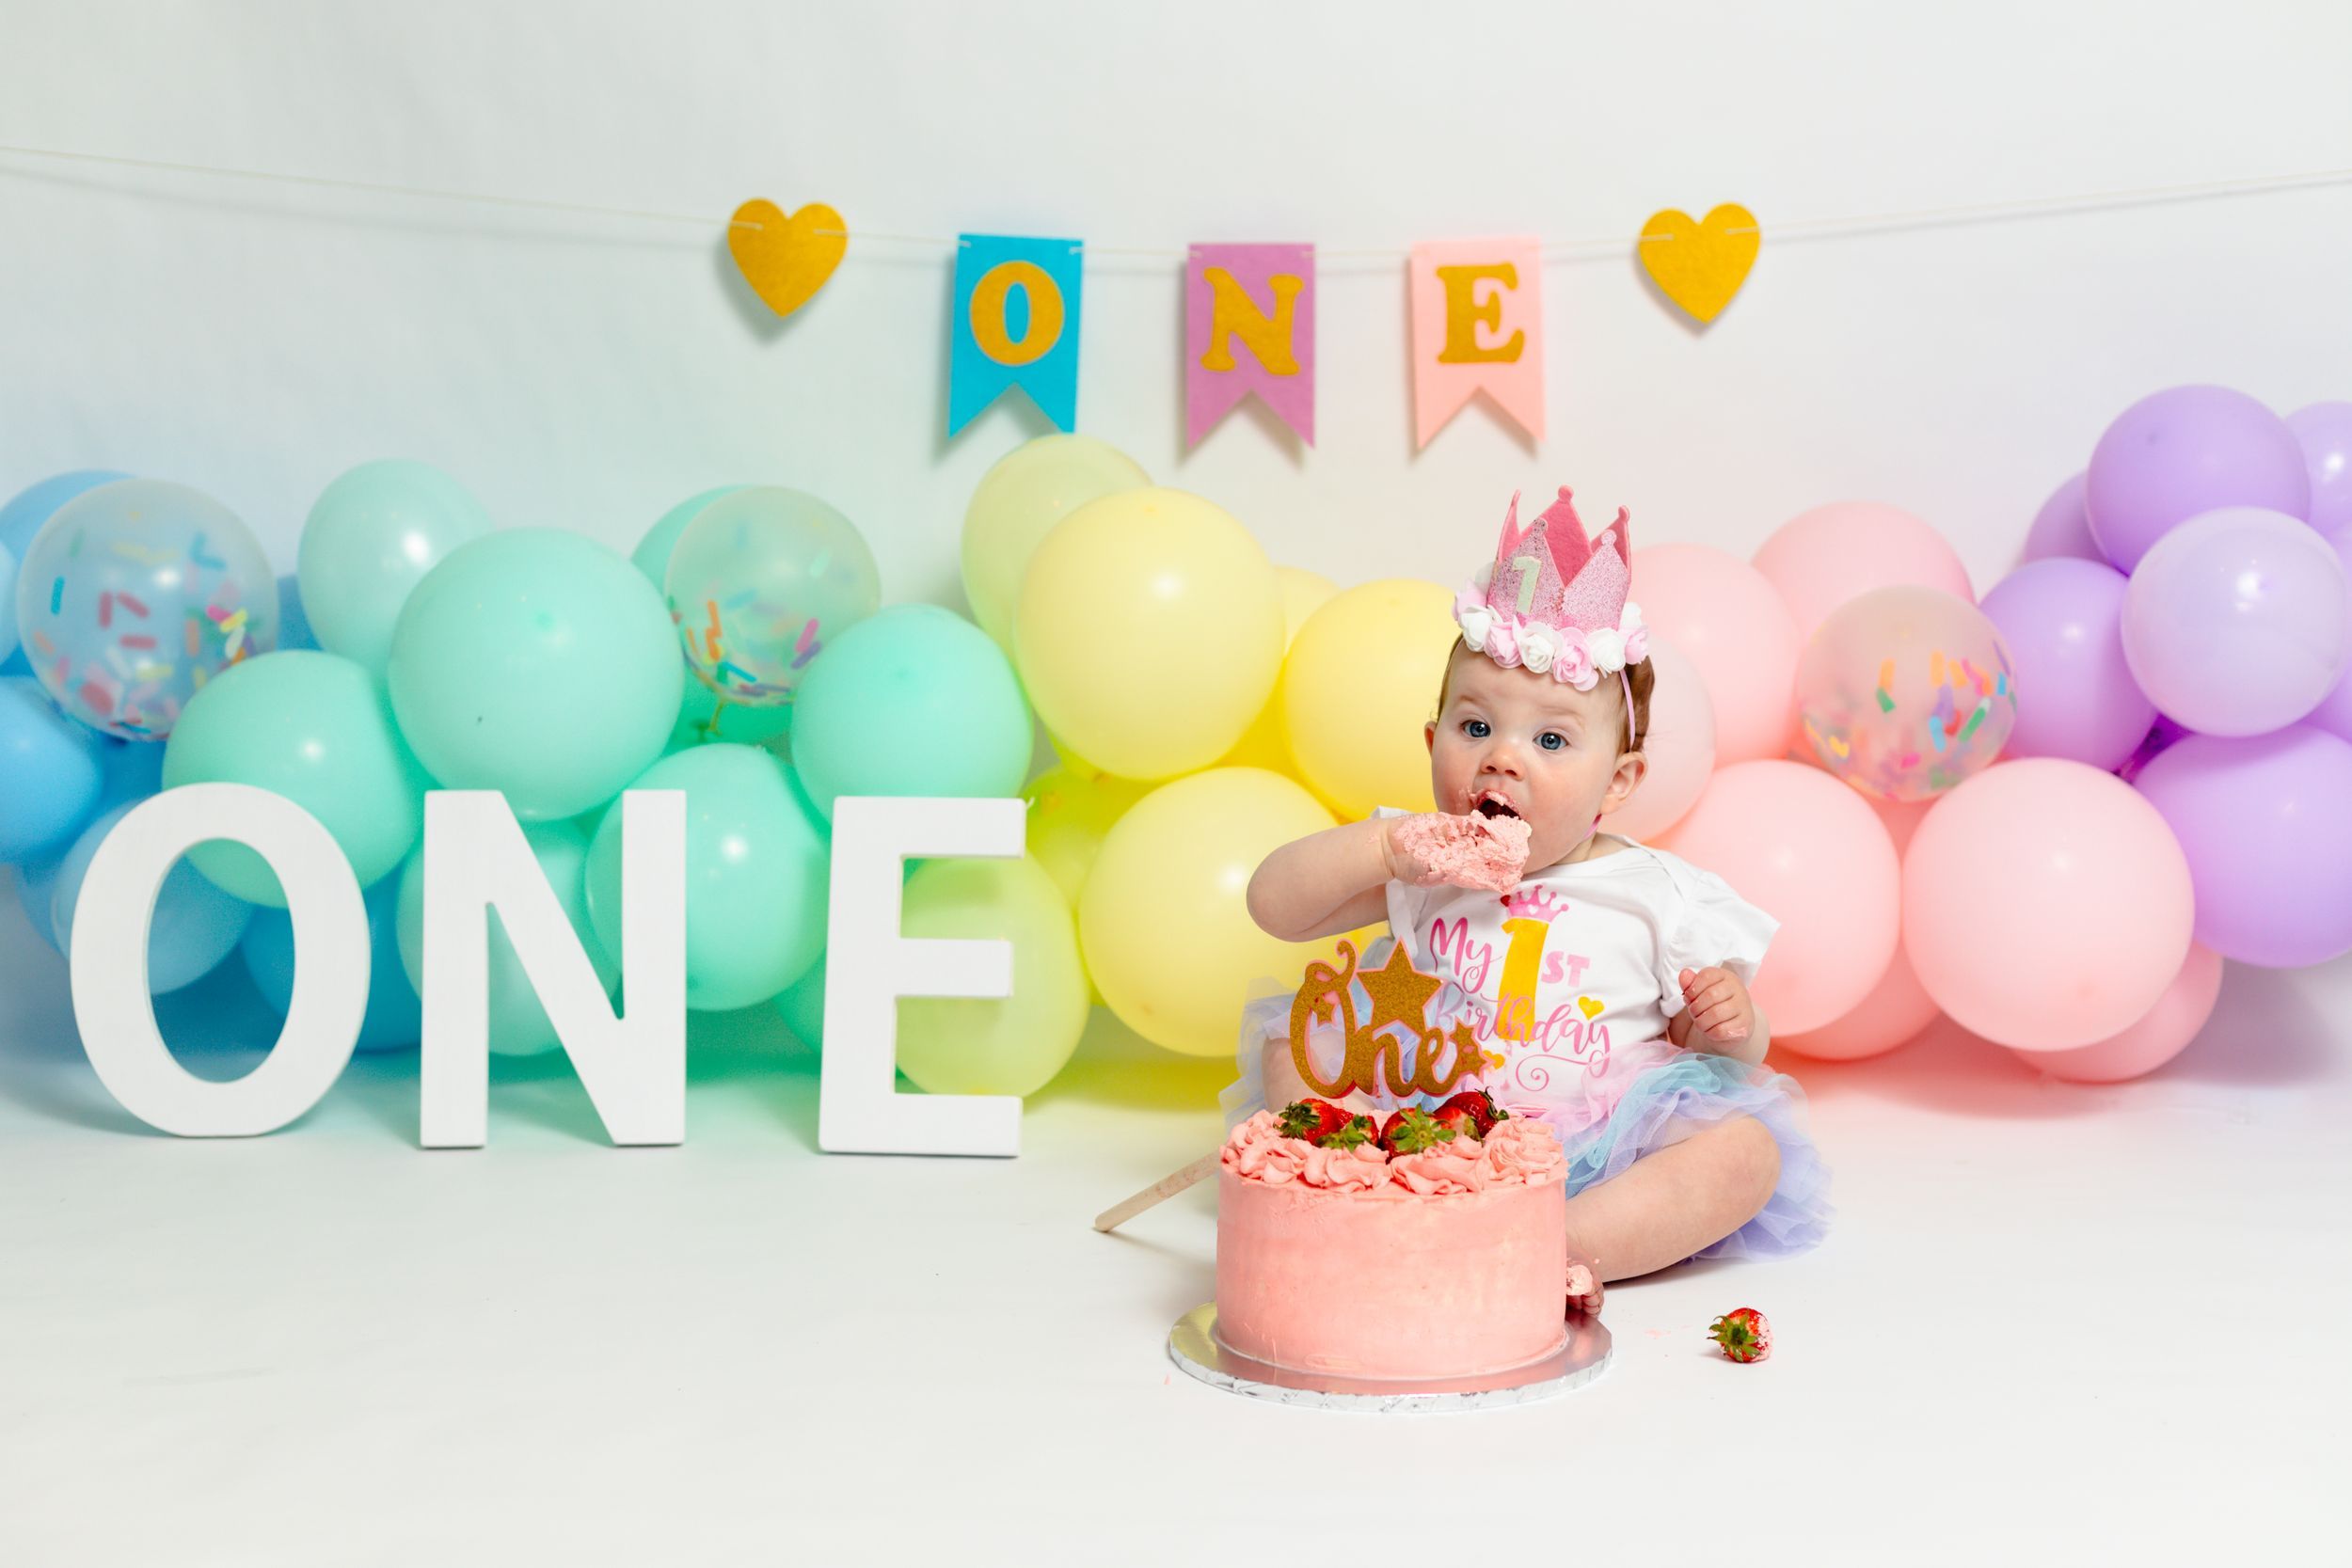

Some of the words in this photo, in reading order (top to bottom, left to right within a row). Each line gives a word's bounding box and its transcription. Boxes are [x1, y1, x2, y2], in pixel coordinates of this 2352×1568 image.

[969, 261, 1525, 375] ONE
[1513, 556, 1542, 613] 1
[70, 782, 1026, 1158] ONE
[1429, 917, 1502, 994] My
[1290, 939, 1475, 1099] One
